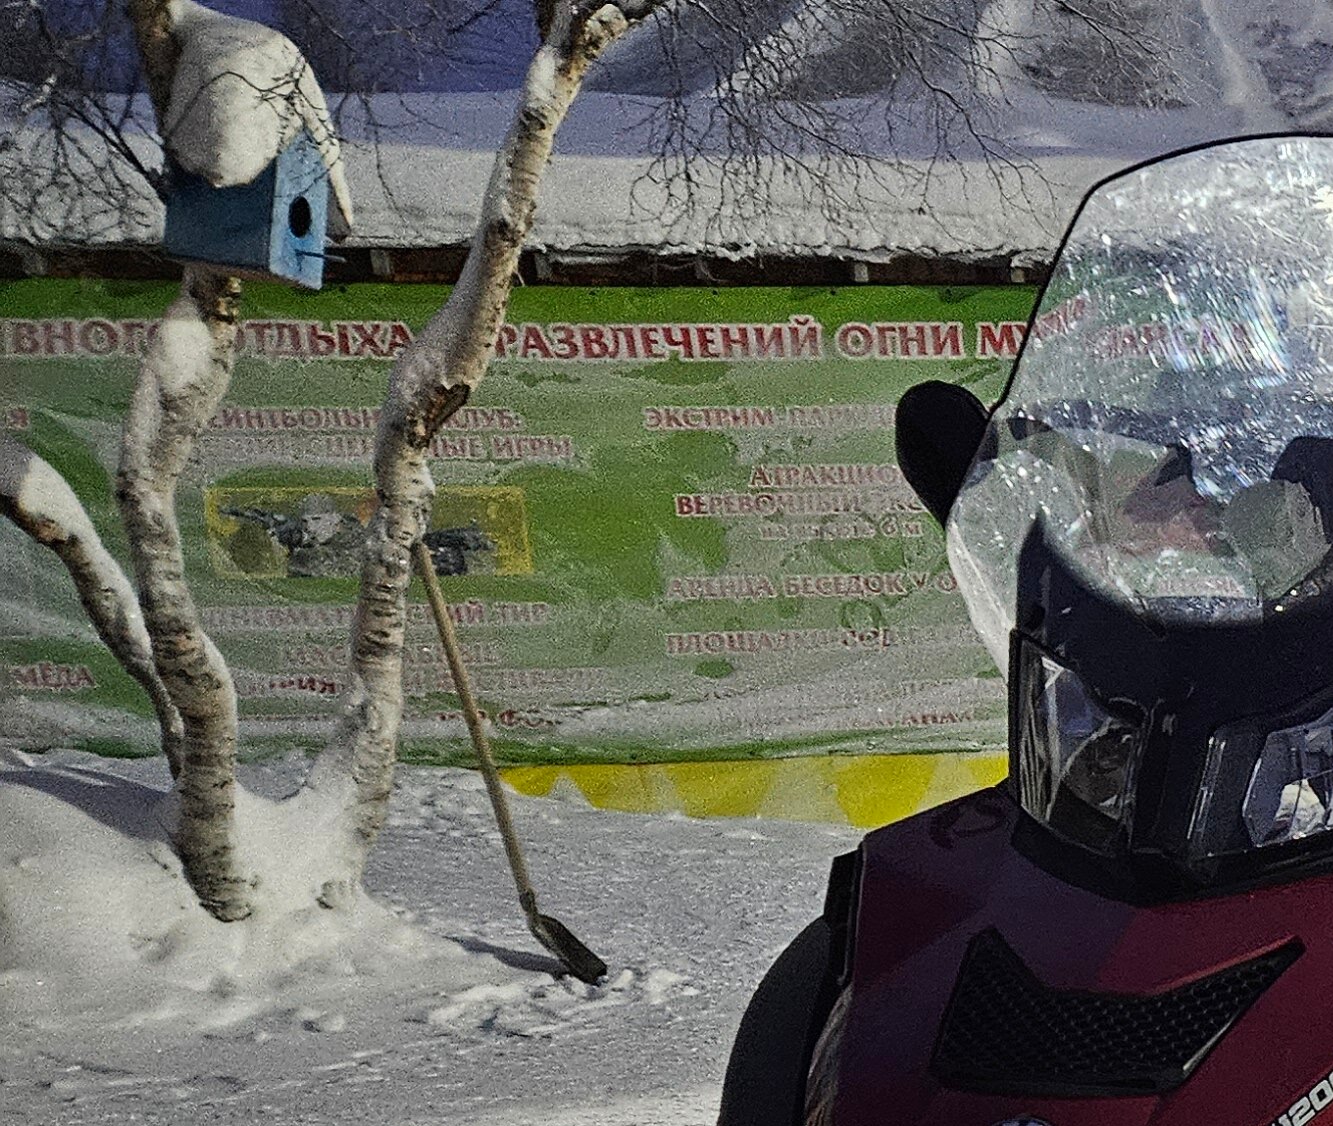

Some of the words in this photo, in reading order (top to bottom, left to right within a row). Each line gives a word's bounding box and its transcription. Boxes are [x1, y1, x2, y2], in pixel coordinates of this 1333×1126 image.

[496, 316, 819, 359] РАЗВЛЕЧЕНИЙ
[837, 321, 963, 358] ОГНИ
[492, 437, 571, 458] ИГРЫ
[751, 464, 903, 487] АТРАКЦИО
[784, 573, 906, 598] БЕСЕДОК
